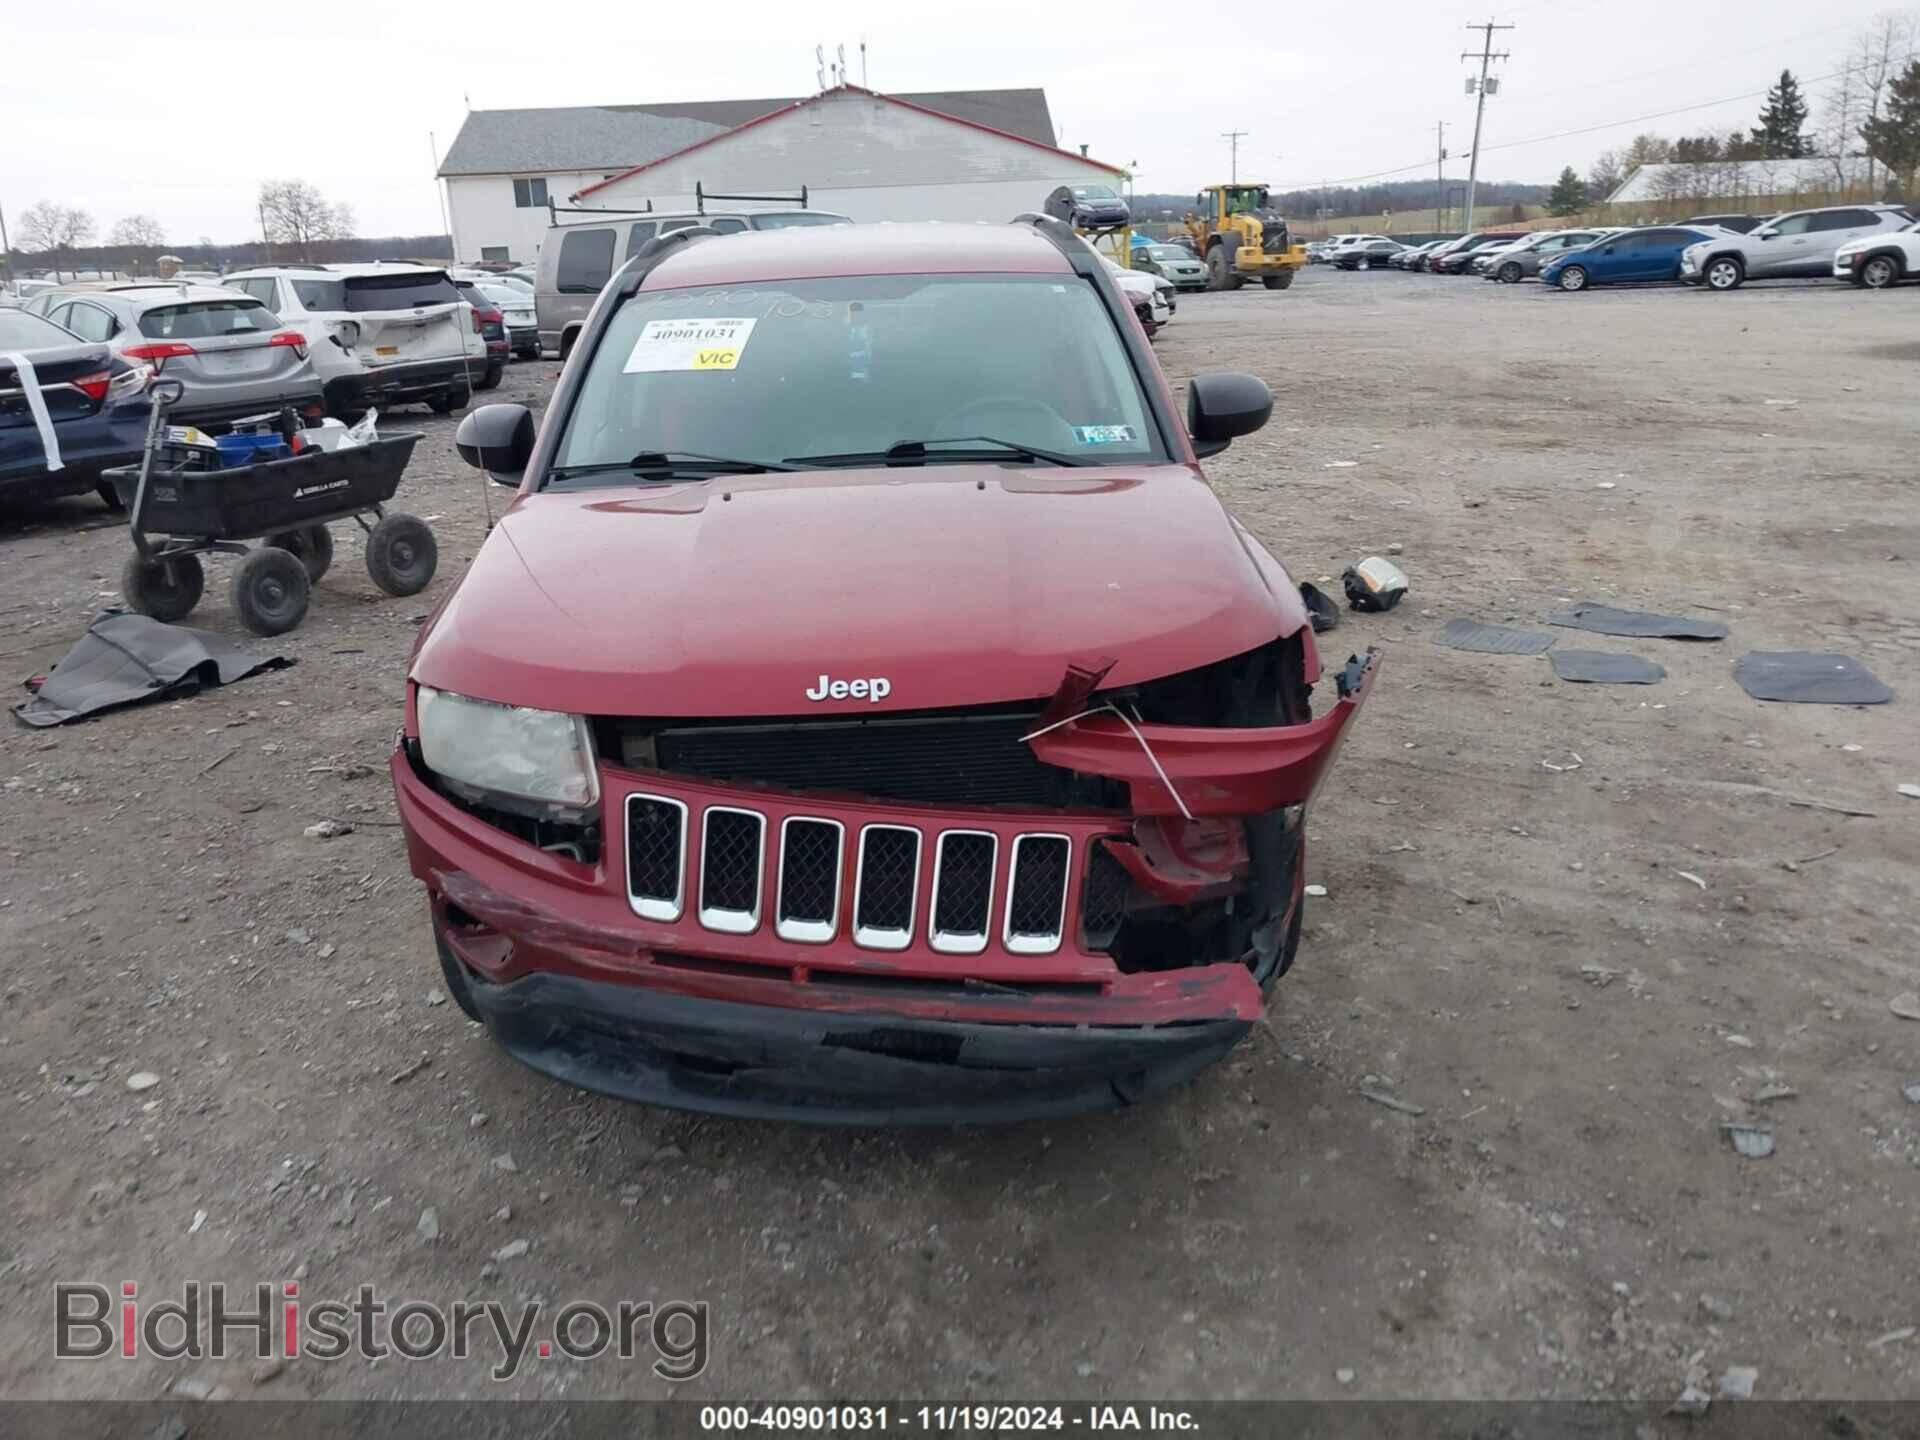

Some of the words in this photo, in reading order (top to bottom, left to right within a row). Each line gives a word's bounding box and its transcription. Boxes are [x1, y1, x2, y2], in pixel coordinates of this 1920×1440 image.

[652, 328, 736, 340] 40901031
[699, 352, 735, 365] VIC
[806, 674, 890, 702] Jeep
